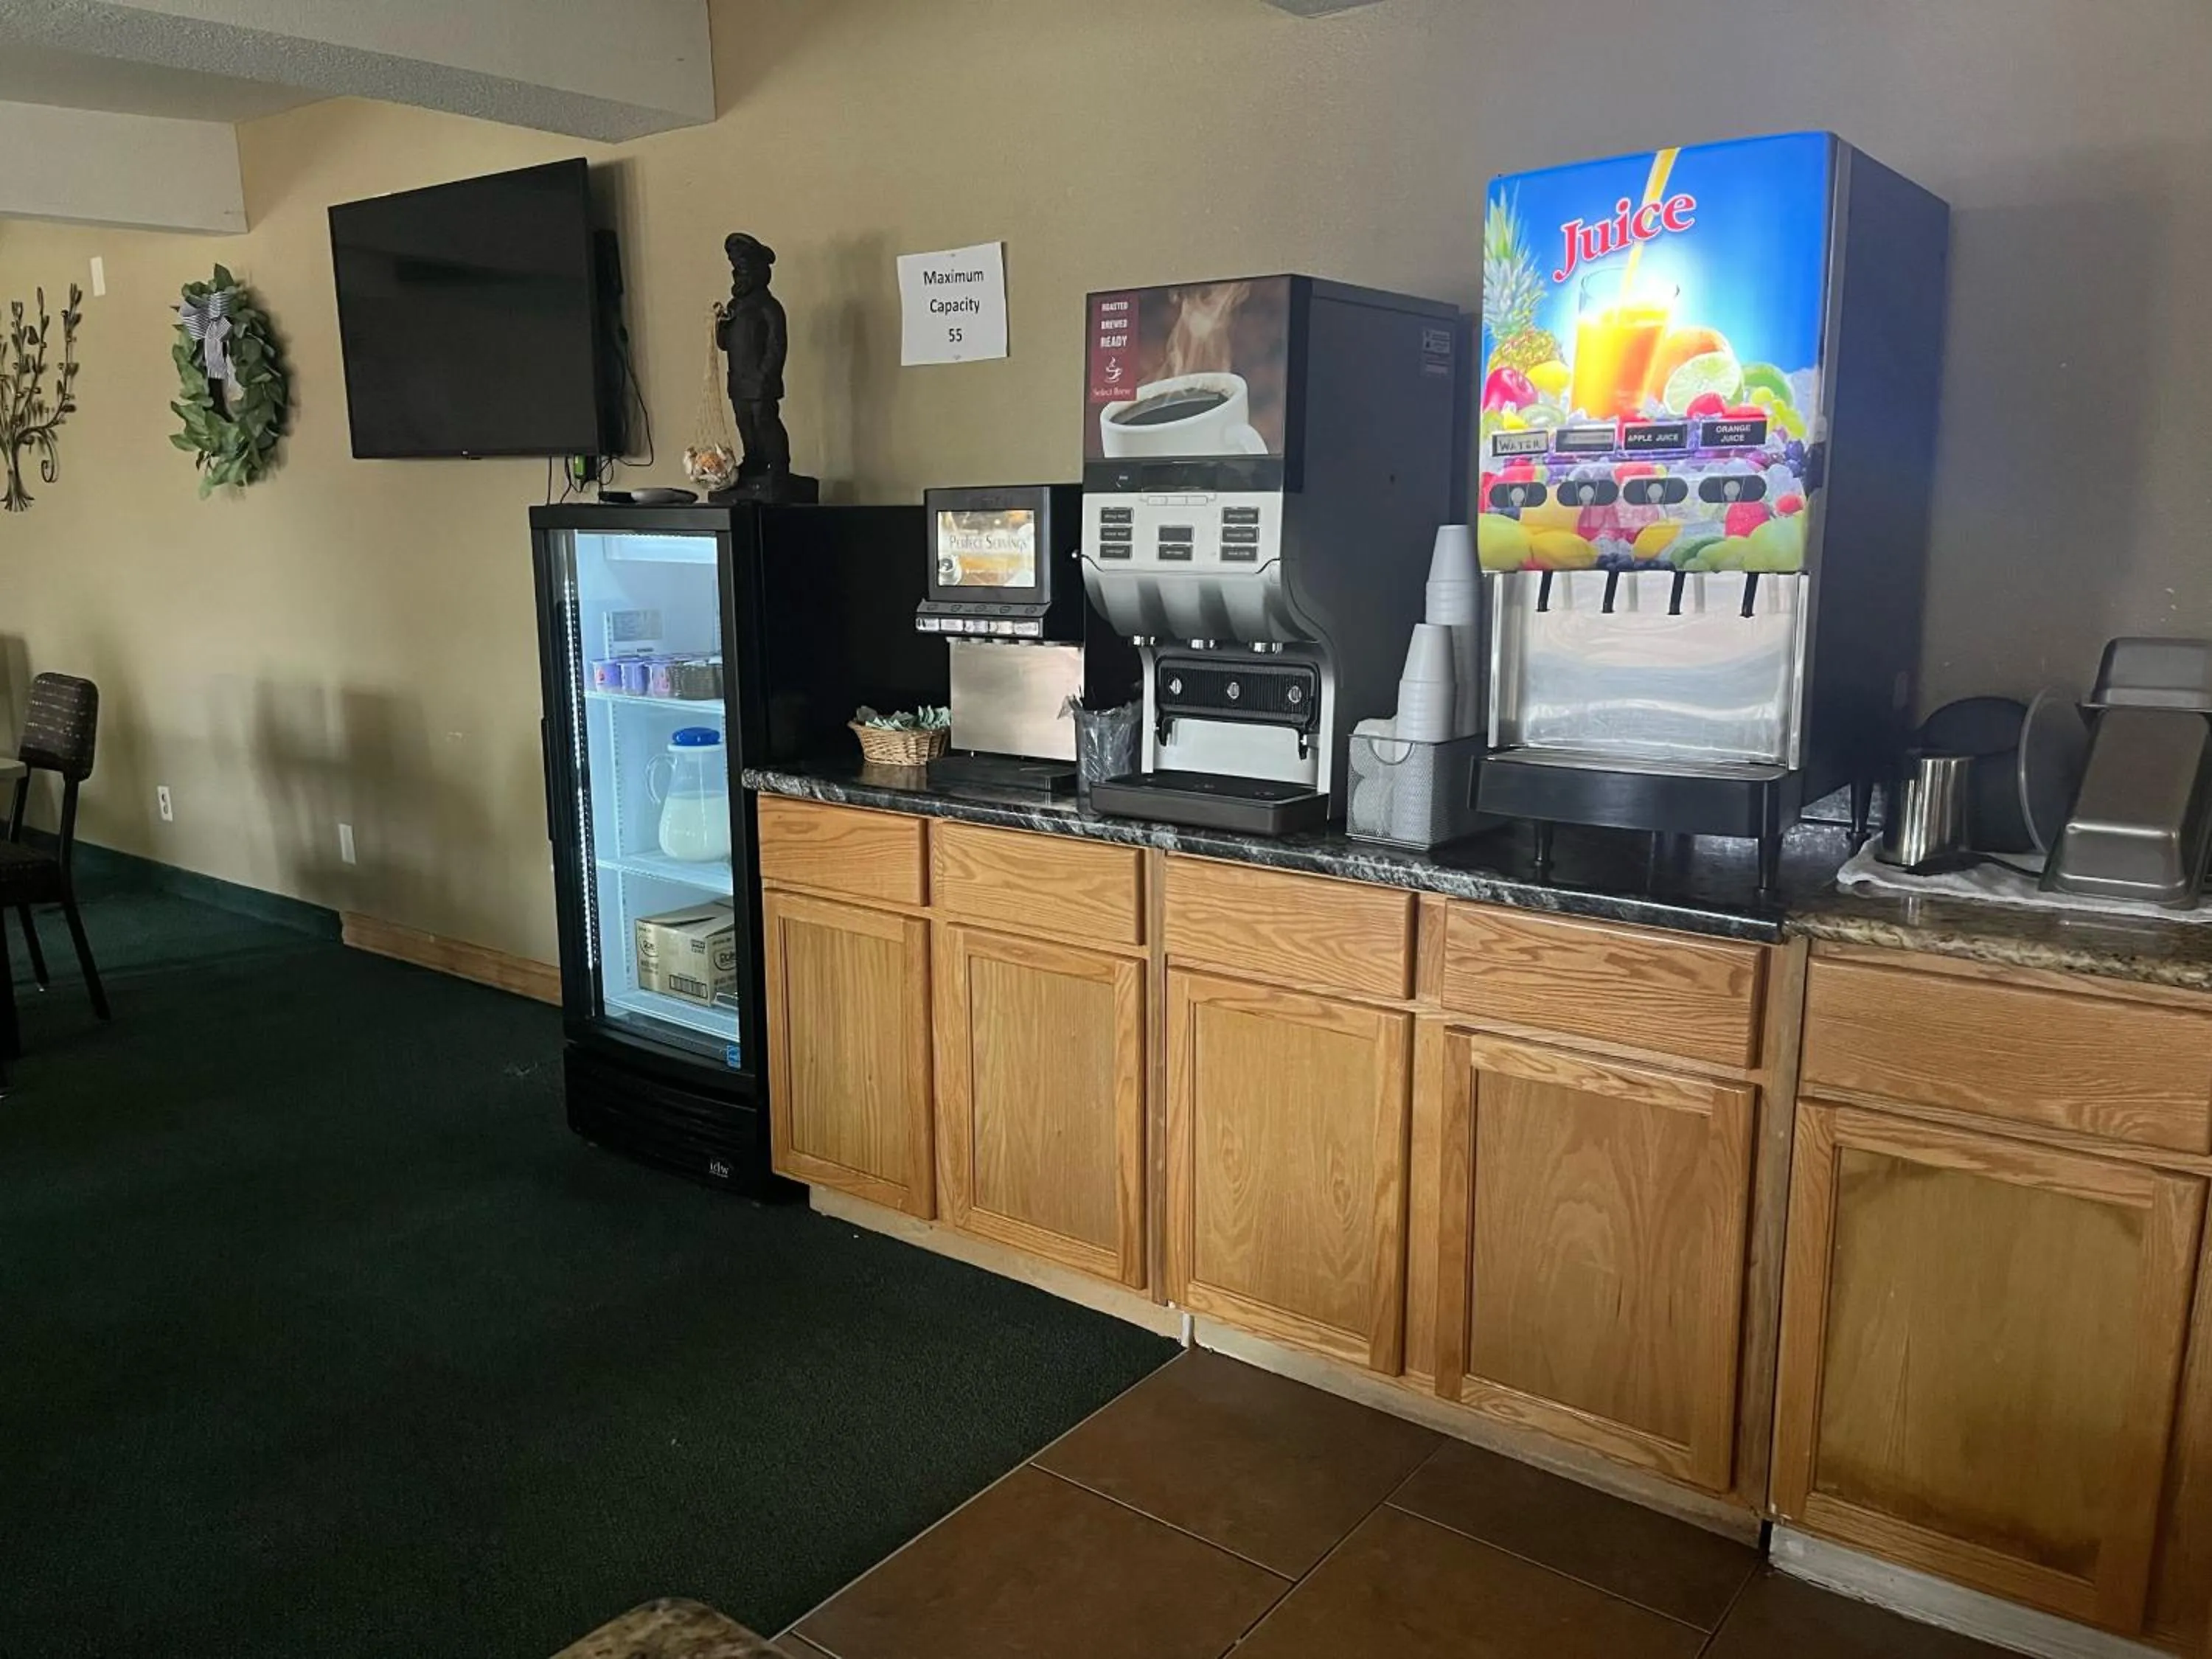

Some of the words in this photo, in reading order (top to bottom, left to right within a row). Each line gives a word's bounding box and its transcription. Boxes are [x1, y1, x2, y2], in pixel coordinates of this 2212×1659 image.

[1552, 193, 1697, 283] Juice
[923, 269, 984, 286] Maximum
[929, 296, 981, 316] Capacity
[948, 327, 963, 343] 55
[1100, 335, 1127, 348] READY
[1716, 424, 1752, 434] ORANGE
[1627, 433, 1653, 442] APPLE
[1656, 432, 1679, 442] JUICE
[1720, 434, 1745, 443] JUICE
[1498, 439, 1543, 452] WATER
